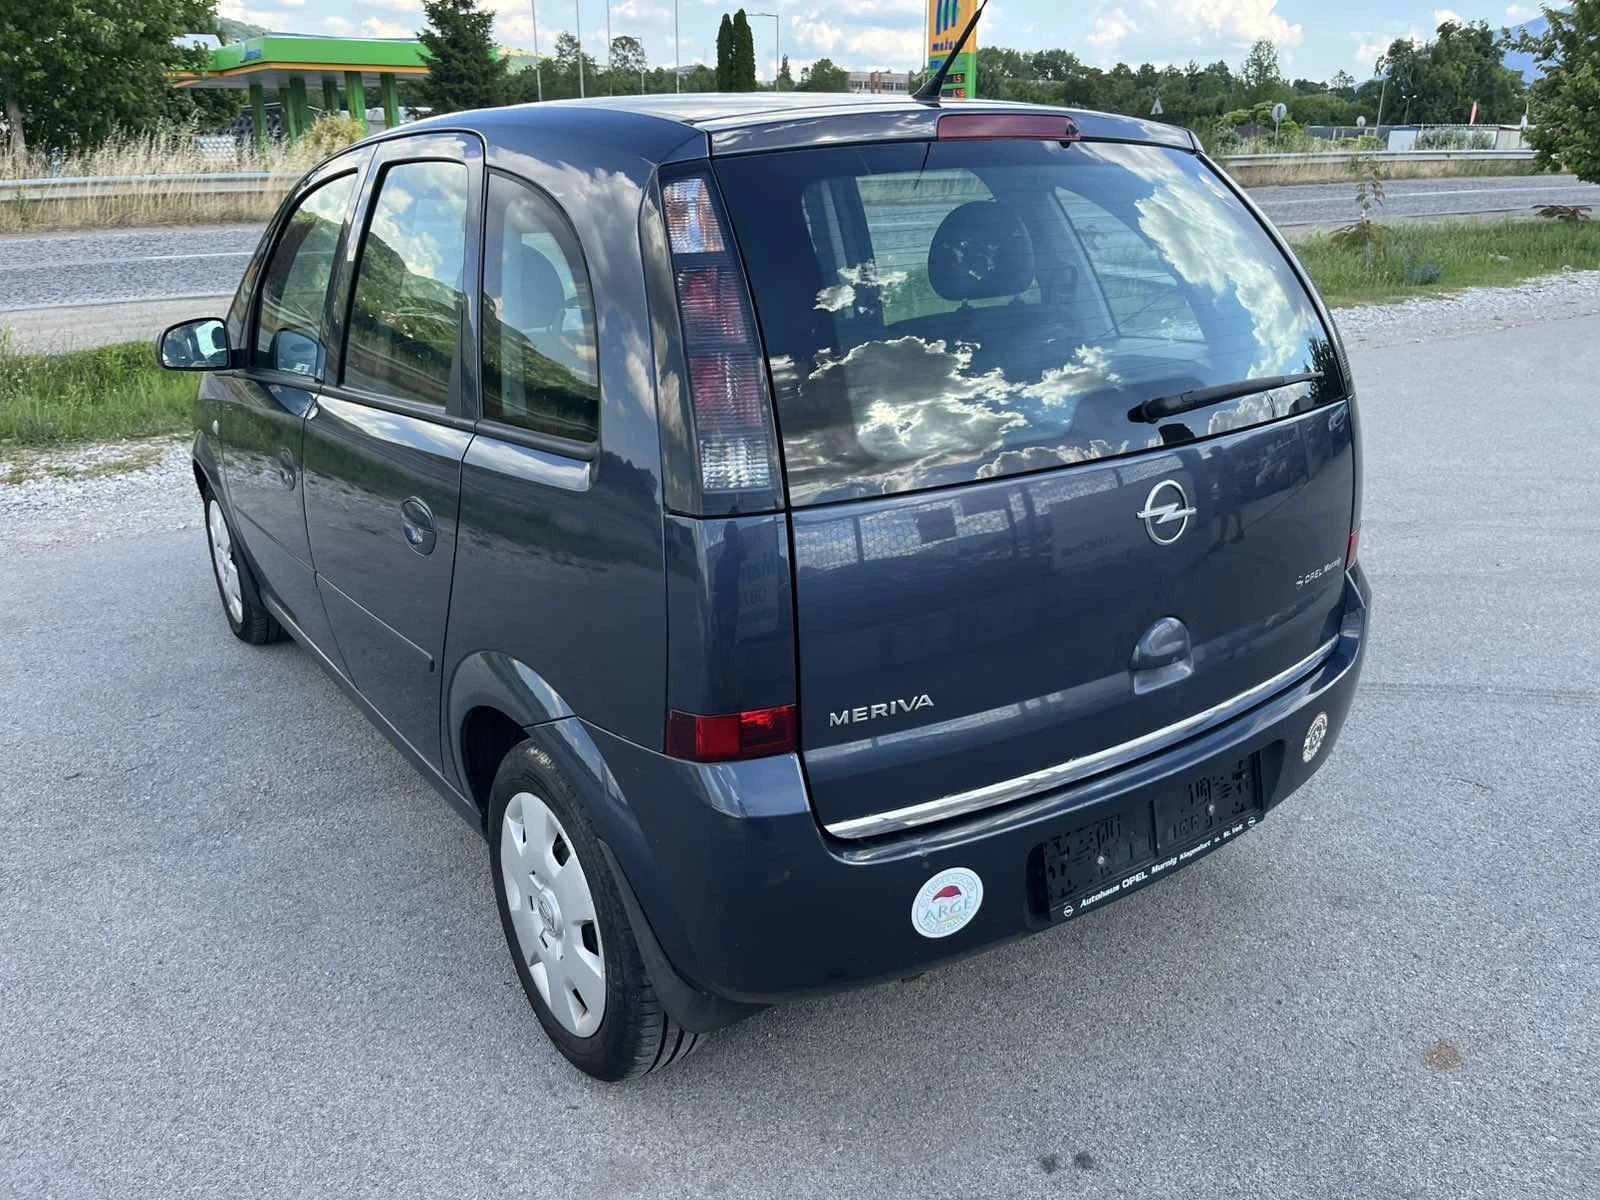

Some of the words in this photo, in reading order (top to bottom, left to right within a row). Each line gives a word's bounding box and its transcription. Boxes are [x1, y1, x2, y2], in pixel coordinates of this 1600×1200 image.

[829, 694, 934, 727] MERIVA
[1080, 884, 1120, 908] Autohaus
[1122, 871, 1148, 888] OPEL
[1151, 857, 1178, 874] Murnig
[923, 896, 971, 921] ARGE
